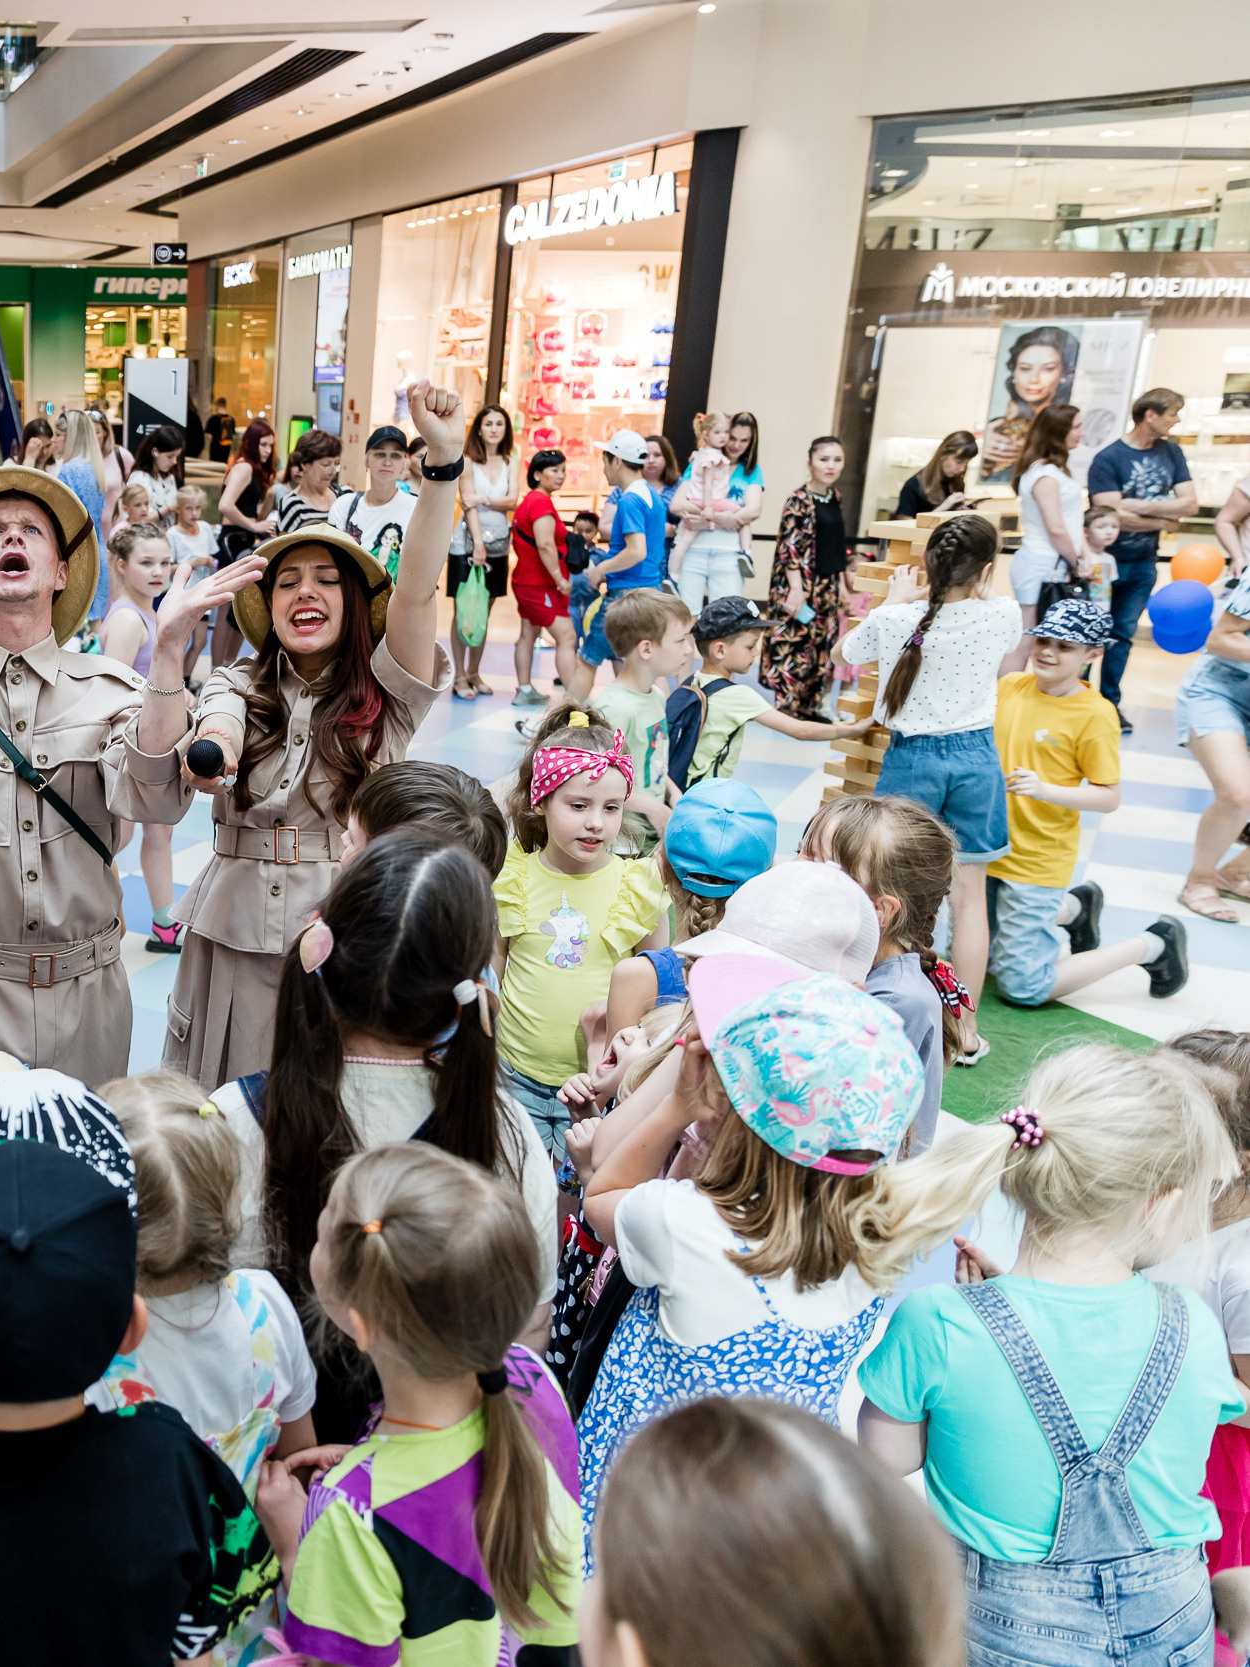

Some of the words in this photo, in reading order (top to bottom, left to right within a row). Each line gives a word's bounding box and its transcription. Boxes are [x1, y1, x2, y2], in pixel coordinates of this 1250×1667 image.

[504, 171, 677, 246] CALZEDONIA
[288, 244, 353, 280] БАНКОМАТЫ
[956, 272, 1128, 299] МОСКОВСКИЙ
[1128, 277, 1250, 299] ЮВЕЛИРН
